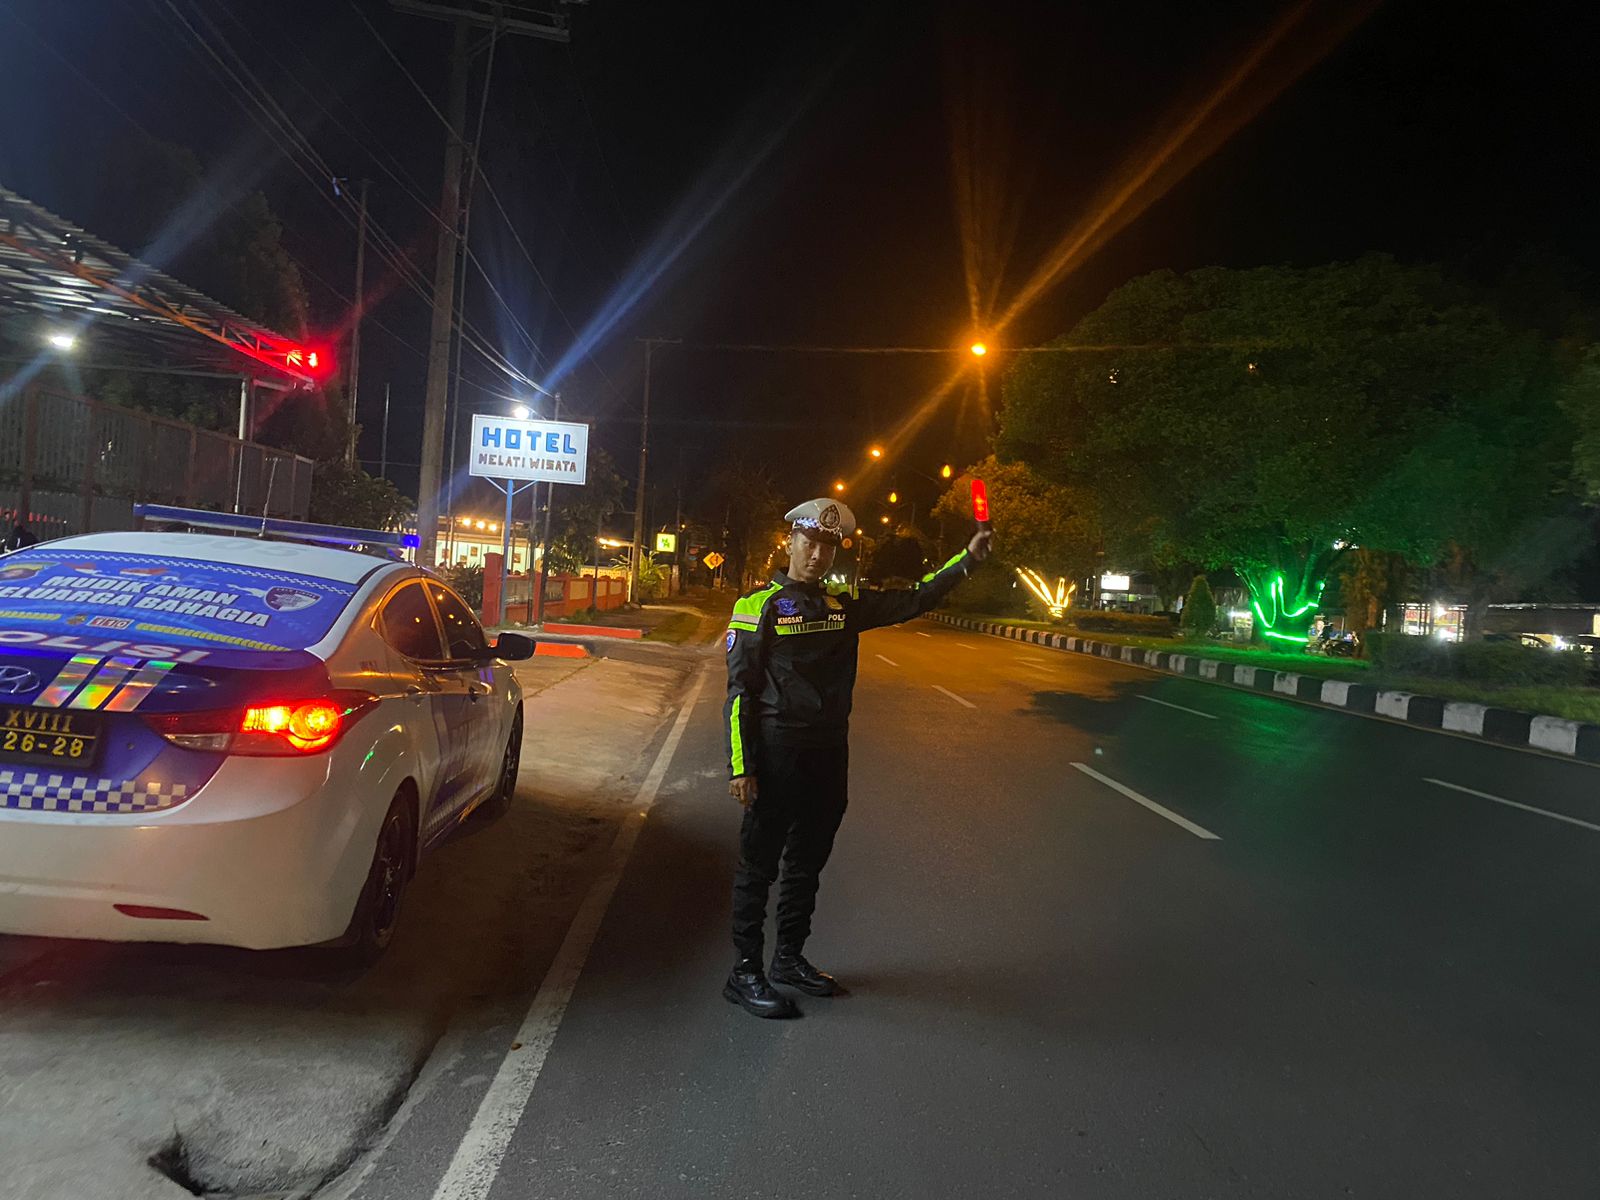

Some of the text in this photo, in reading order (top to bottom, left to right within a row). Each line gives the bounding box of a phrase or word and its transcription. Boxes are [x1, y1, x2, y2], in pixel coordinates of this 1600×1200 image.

[482, 426, 577, 454] HOTEL
[478, 453, 577, 473] MELATI WISATA
[42, 575, 240, 606] MUDIK AMAN
[0, 586, 270, 627] ELUARGA BAHAGIA
[5, 709, 73, 732] XVIII
[3, 731, 84, 758] 26-28
